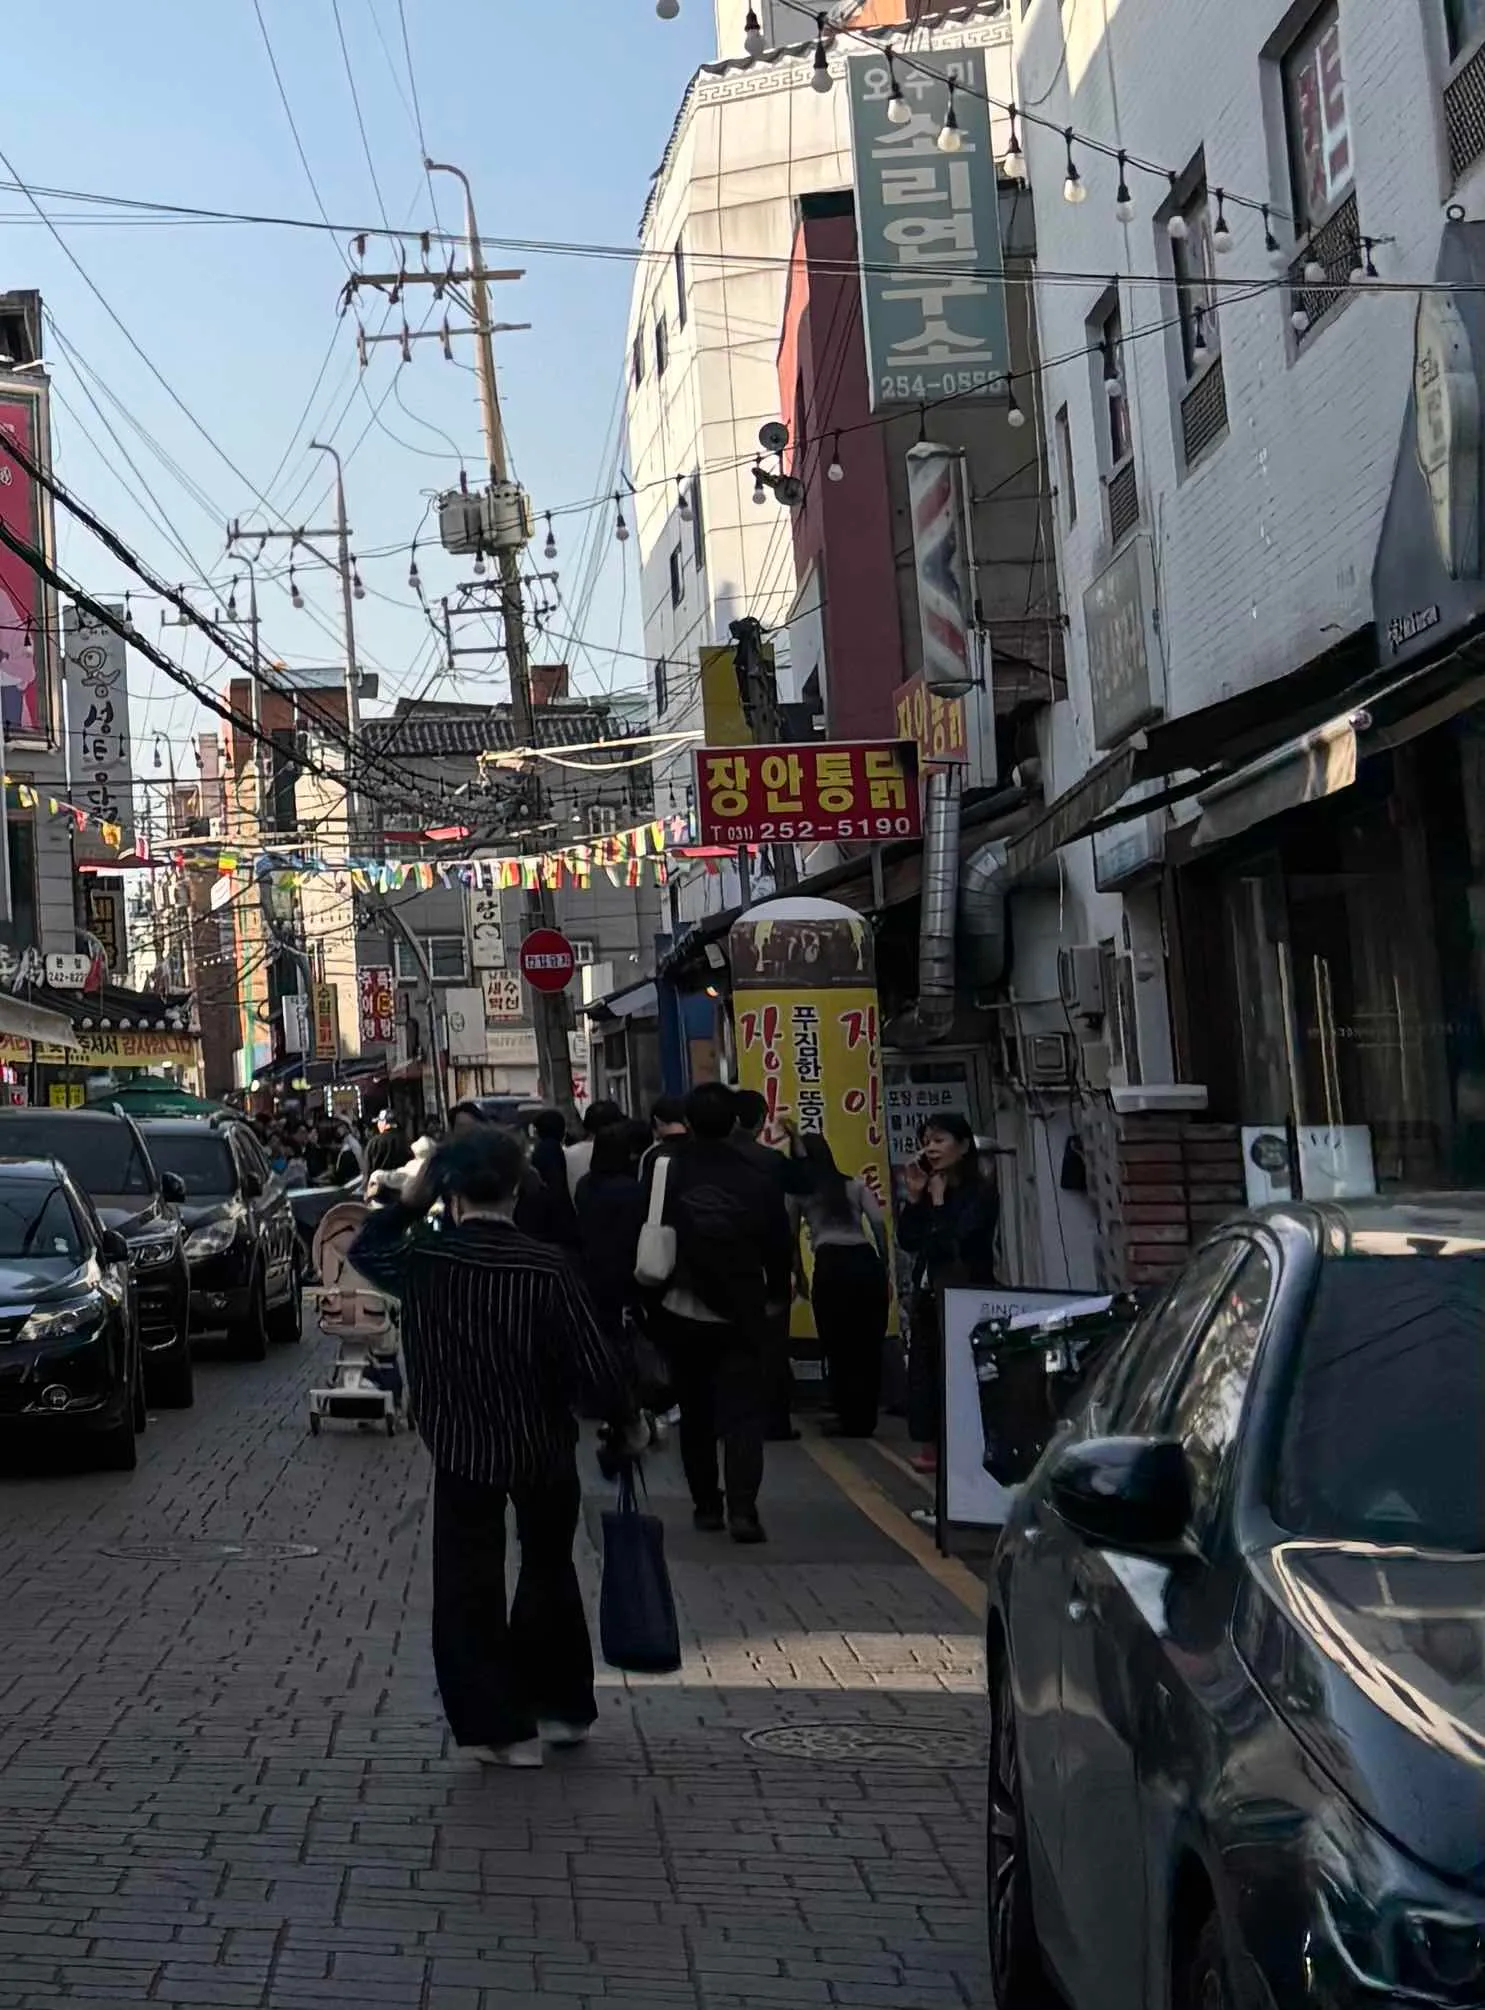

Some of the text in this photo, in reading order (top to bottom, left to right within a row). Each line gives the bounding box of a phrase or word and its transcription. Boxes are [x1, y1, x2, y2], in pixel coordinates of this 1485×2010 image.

[871, 112, 993, 368] 소리연구소
[704, 750, 907, 817] 장안통닭
[760, 817, 911, 840] 252-5190
[791, 1004, 821, 1083] 푸짐한
